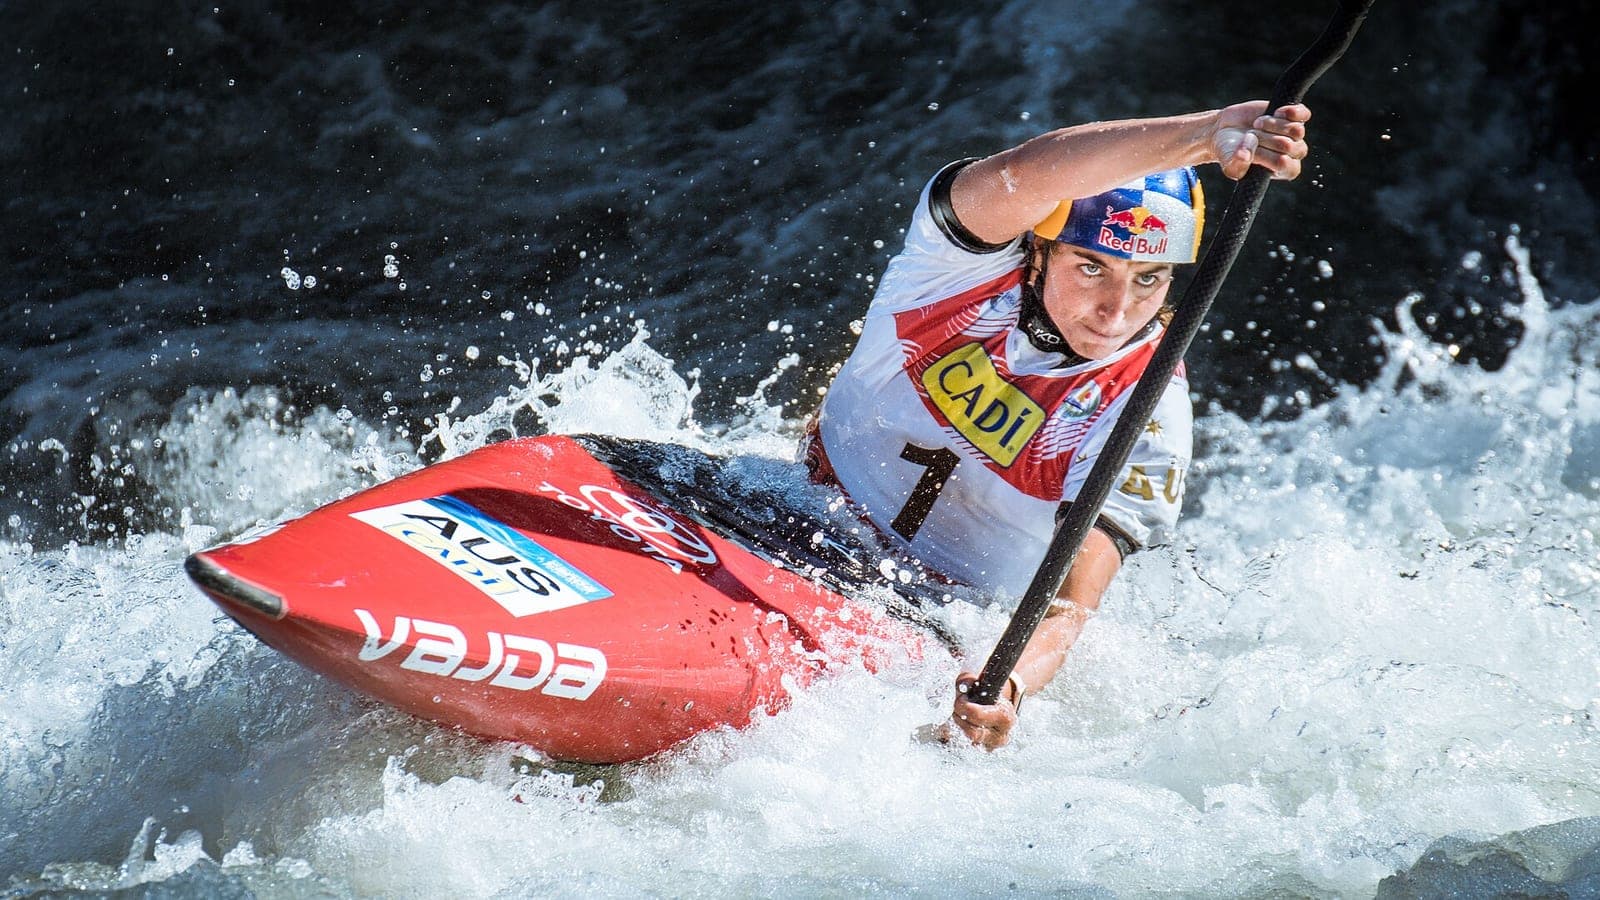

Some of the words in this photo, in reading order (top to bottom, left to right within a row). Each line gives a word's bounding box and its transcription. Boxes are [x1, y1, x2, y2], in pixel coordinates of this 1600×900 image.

[1098, 226, 1136, 253] Red
[1136, 237, 1168, 255] Bull
[538, 481, 683, 575] TOYOTA
[889, 441, 961, 543] 1
[401, 512, 561, 597] AUS
